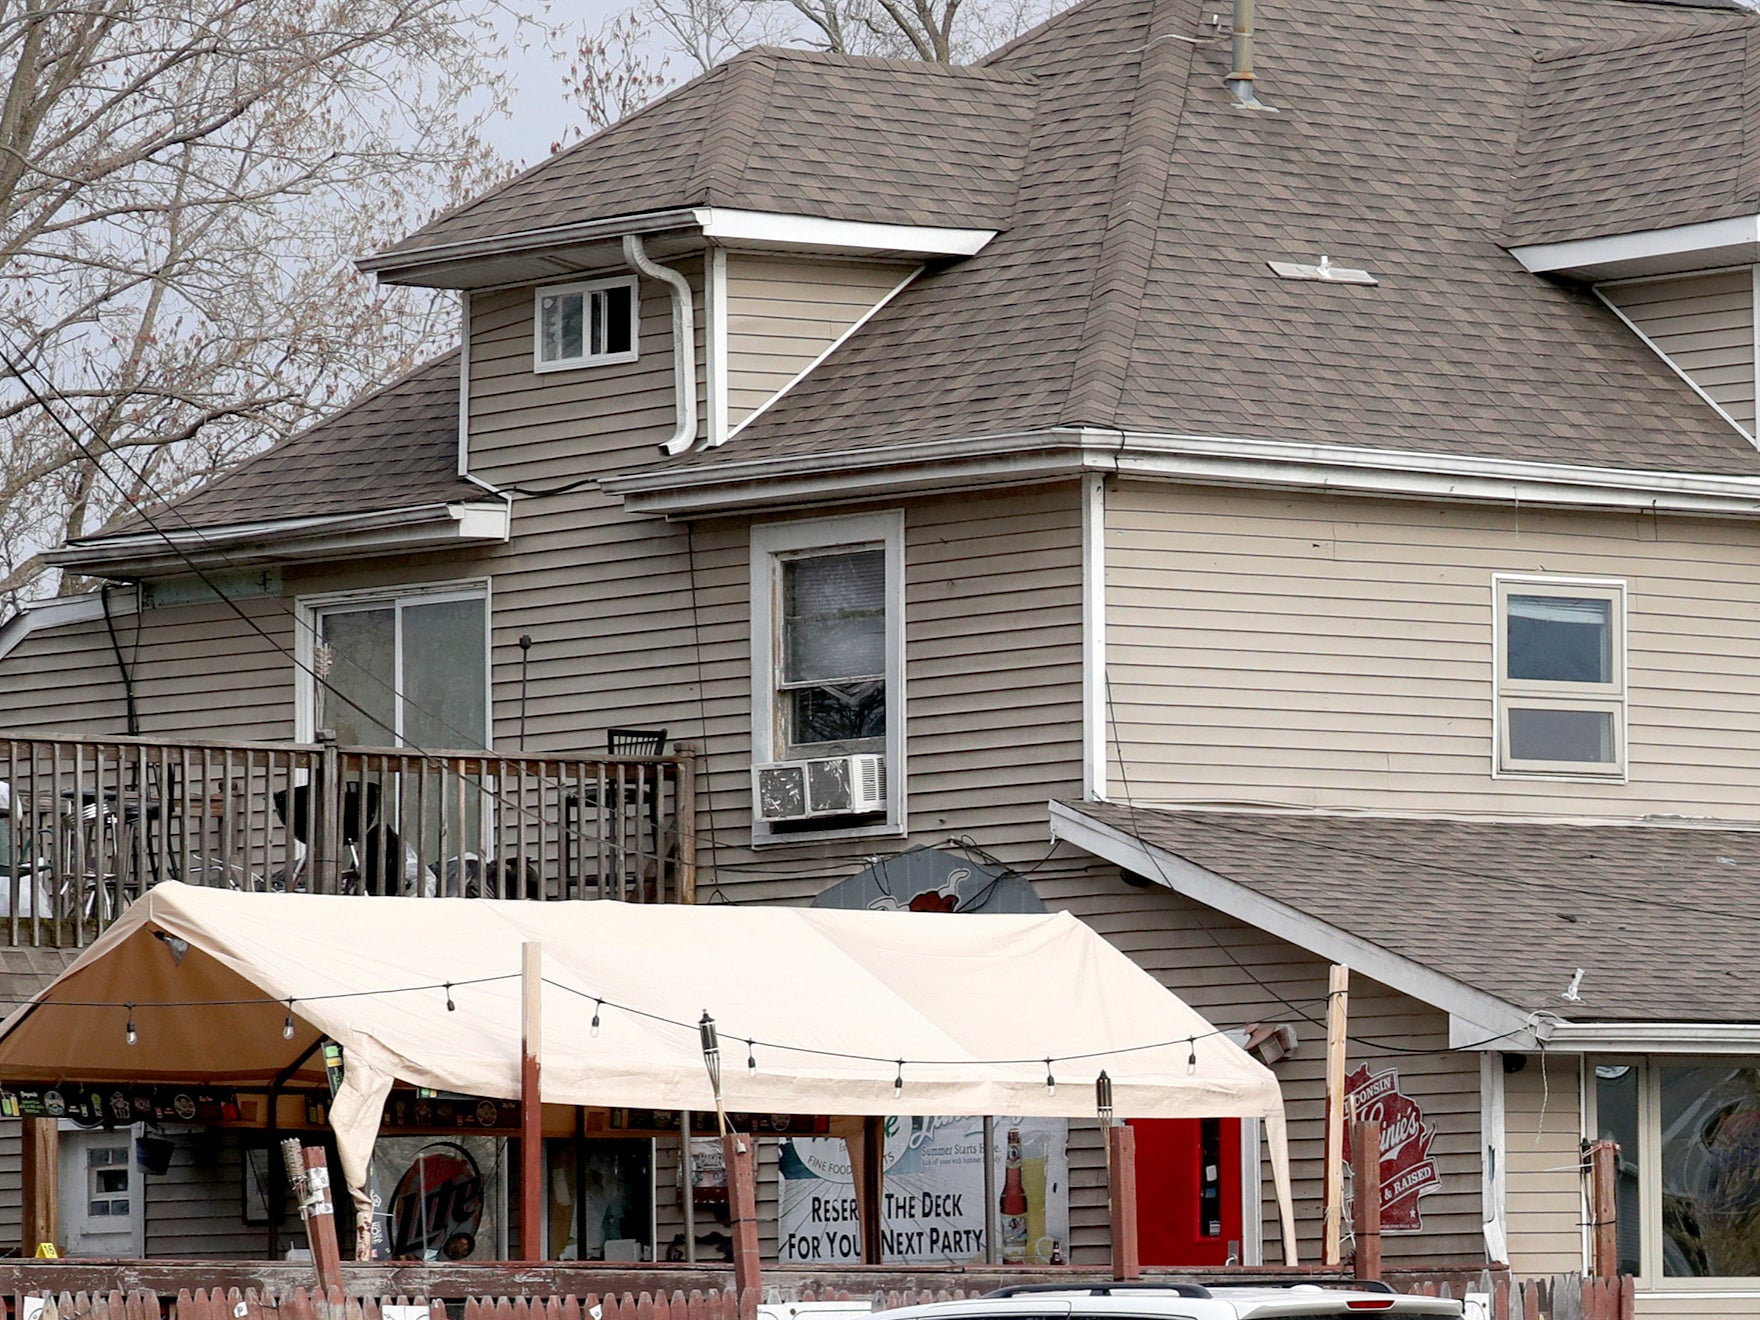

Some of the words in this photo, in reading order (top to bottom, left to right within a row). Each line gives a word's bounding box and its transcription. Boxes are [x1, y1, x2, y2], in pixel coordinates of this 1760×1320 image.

[808, 1155, 827, 1172] FINE
[921, 1145, 953, 1157] Summer
[954, 1143, 977, 1155] Starts
[1393, 1166, 1432, 1195] RAISED
[812, 1196, 859, 1223] RESER
[885, 1194, 917, 1219] THE
[922, 1192, 963, 1218] DECK
[788, 1233, 821, 1259] FOR
[826, 1231, 861, 1258] YOU
[881, 1229, 924, 1256] NEXT
[930, 1227, 983, 1253] PARTY
